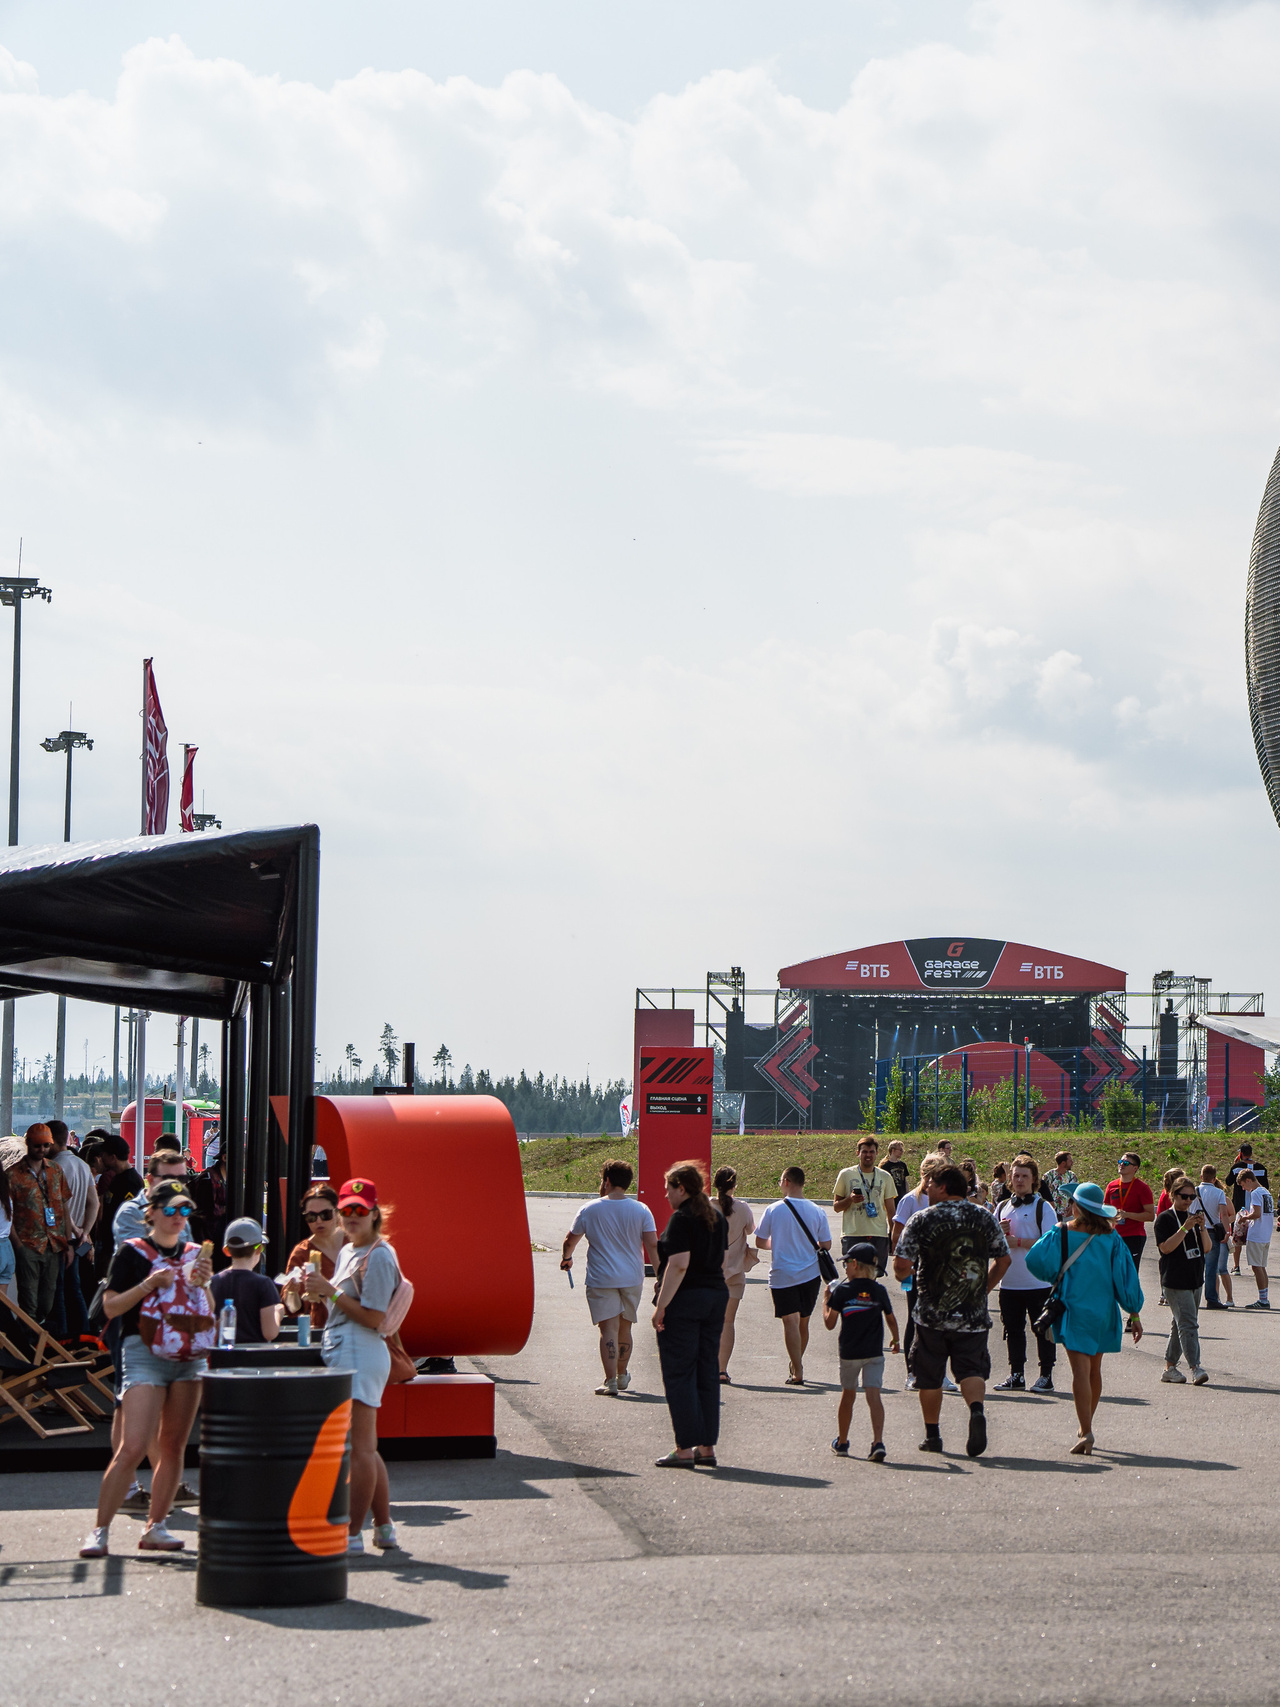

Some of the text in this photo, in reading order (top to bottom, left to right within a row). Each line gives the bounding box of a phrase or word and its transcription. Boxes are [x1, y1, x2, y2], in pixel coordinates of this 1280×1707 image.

[947, 942, 965, 957] G
[860, 964, 890, 978] ВТБ
[1034, 966, 1064, 980] ВТБ
